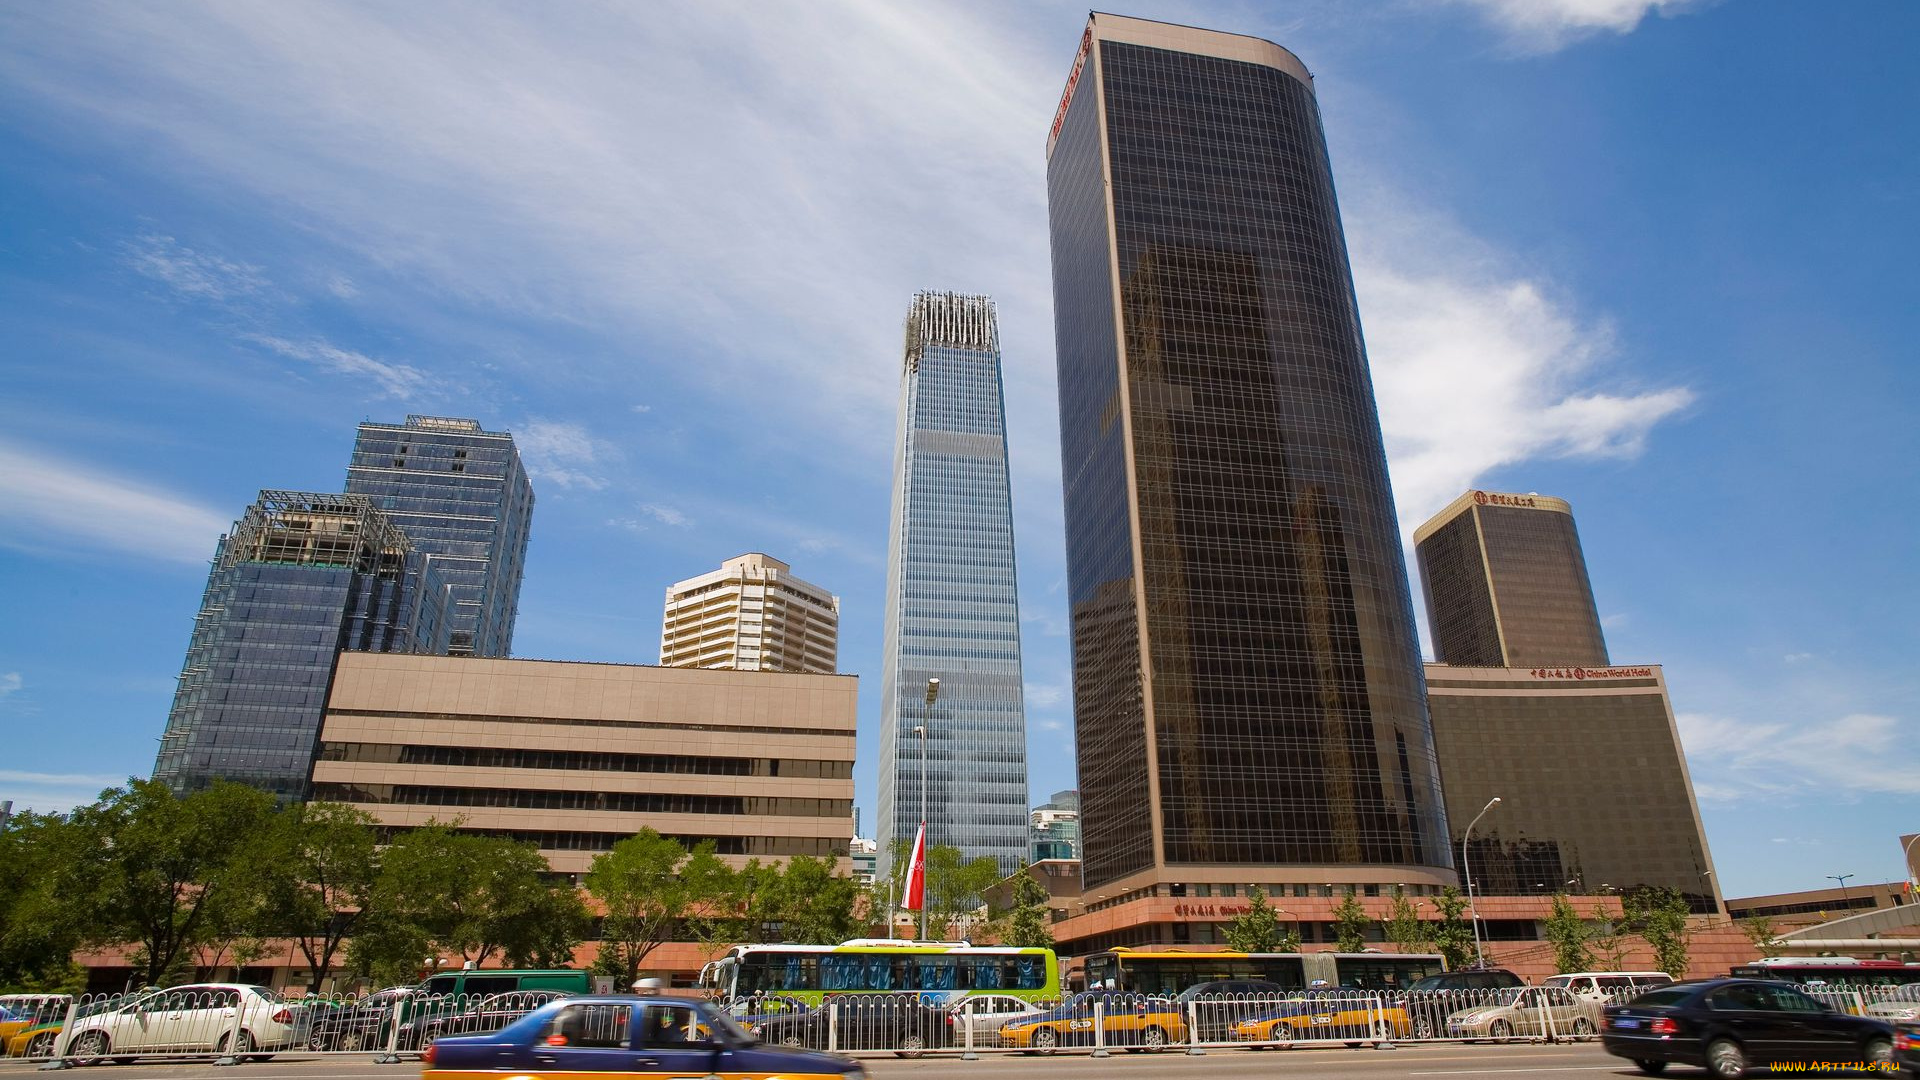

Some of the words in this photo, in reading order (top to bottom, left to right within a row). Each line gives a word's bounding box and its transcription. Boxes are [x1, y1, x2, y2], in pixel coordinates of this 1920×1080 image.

[1586, 669, 1607, 679] China
[1608, 668, 1631, 678] World
[1631, 667, 1652, 677] Hotel
